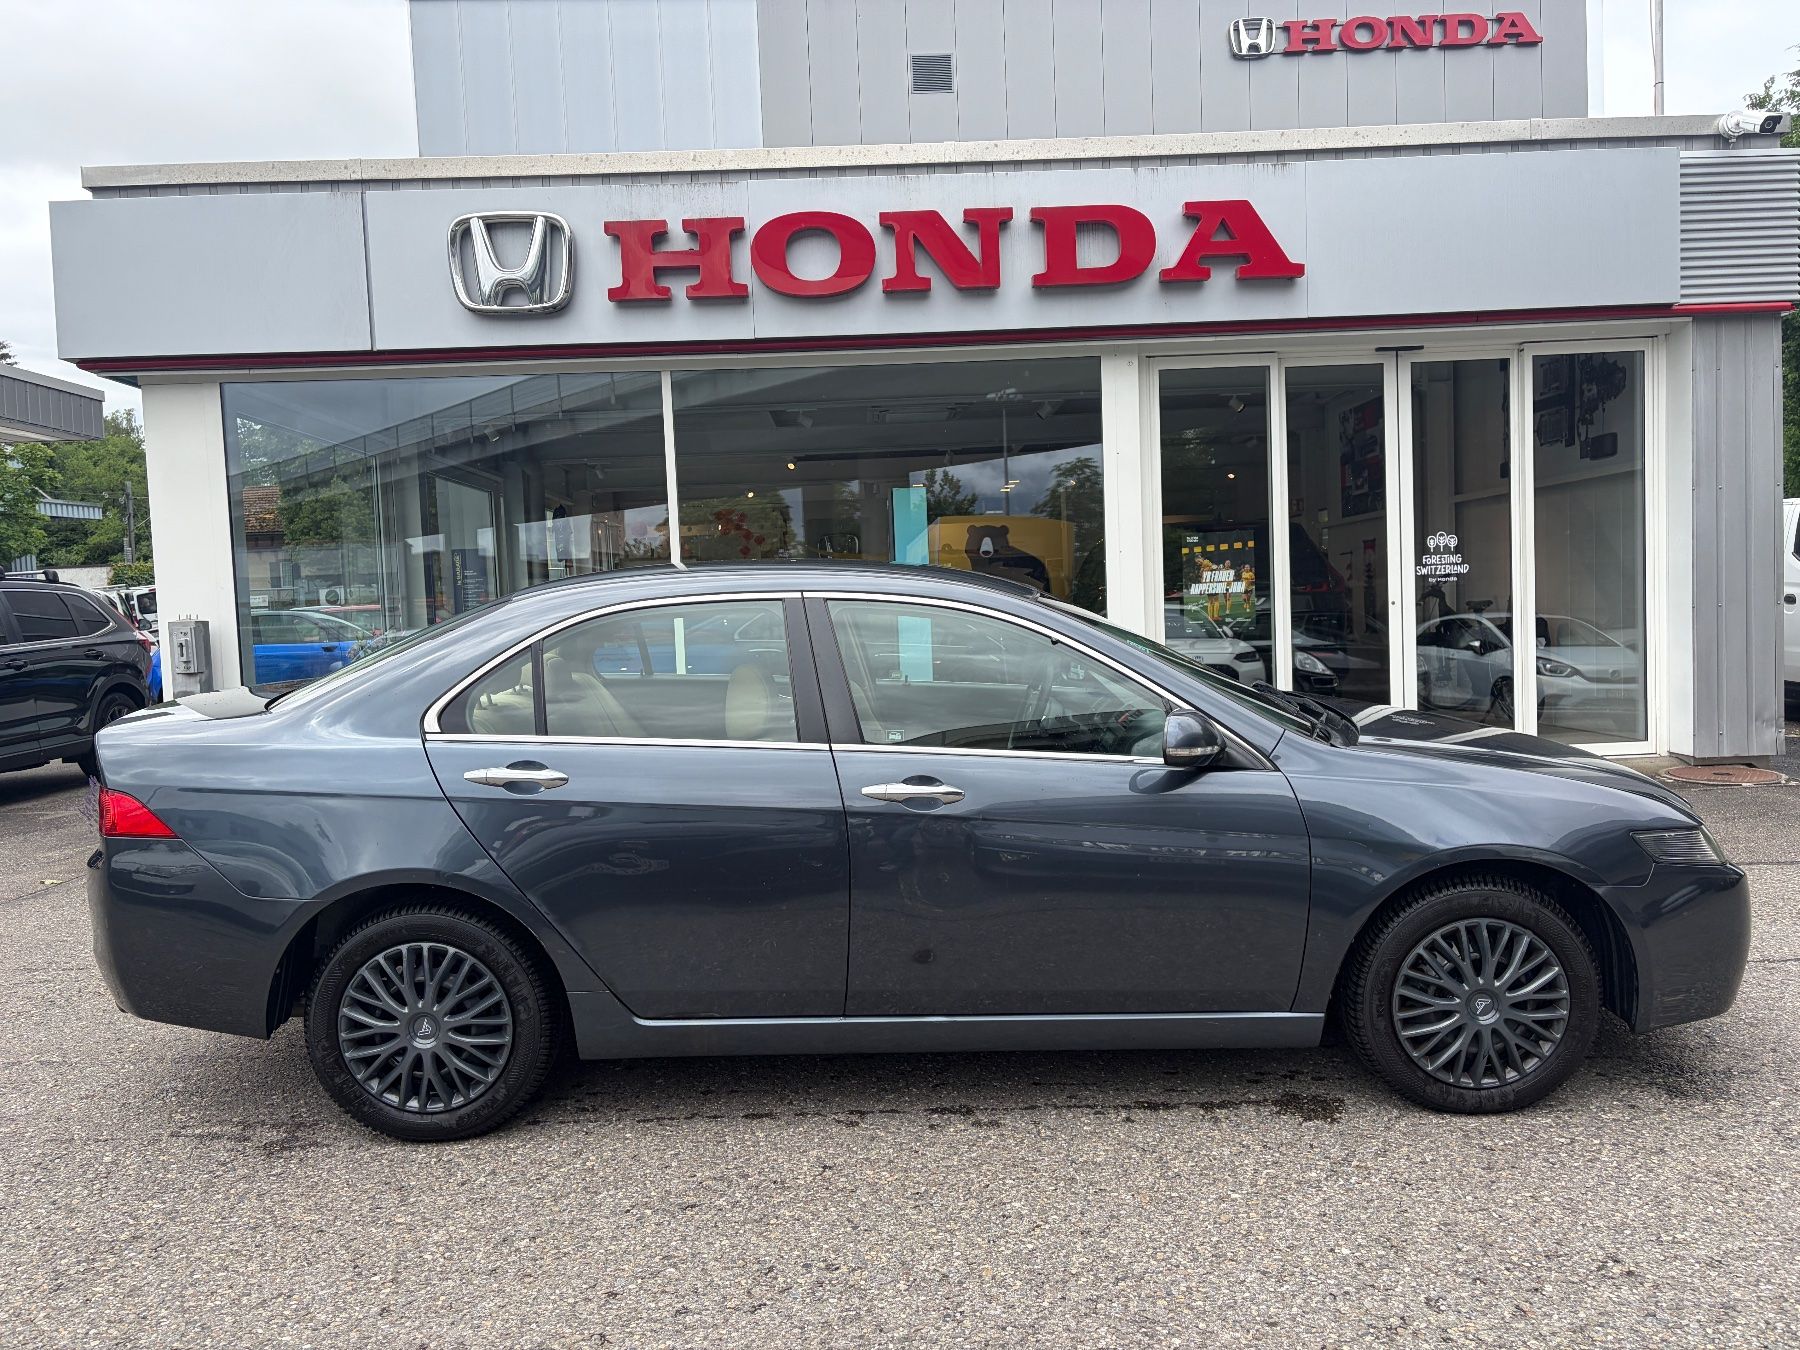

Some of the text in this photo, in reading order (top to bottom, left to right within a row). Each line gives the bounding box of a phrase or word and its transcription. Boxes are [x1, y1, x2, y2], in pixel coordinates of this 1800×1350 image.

[1283, 12, 1544, 53] HONDA
[604, 200, 1305, 303] HONDA
[1416, 564, 1470, 575] SWITZERLAND
